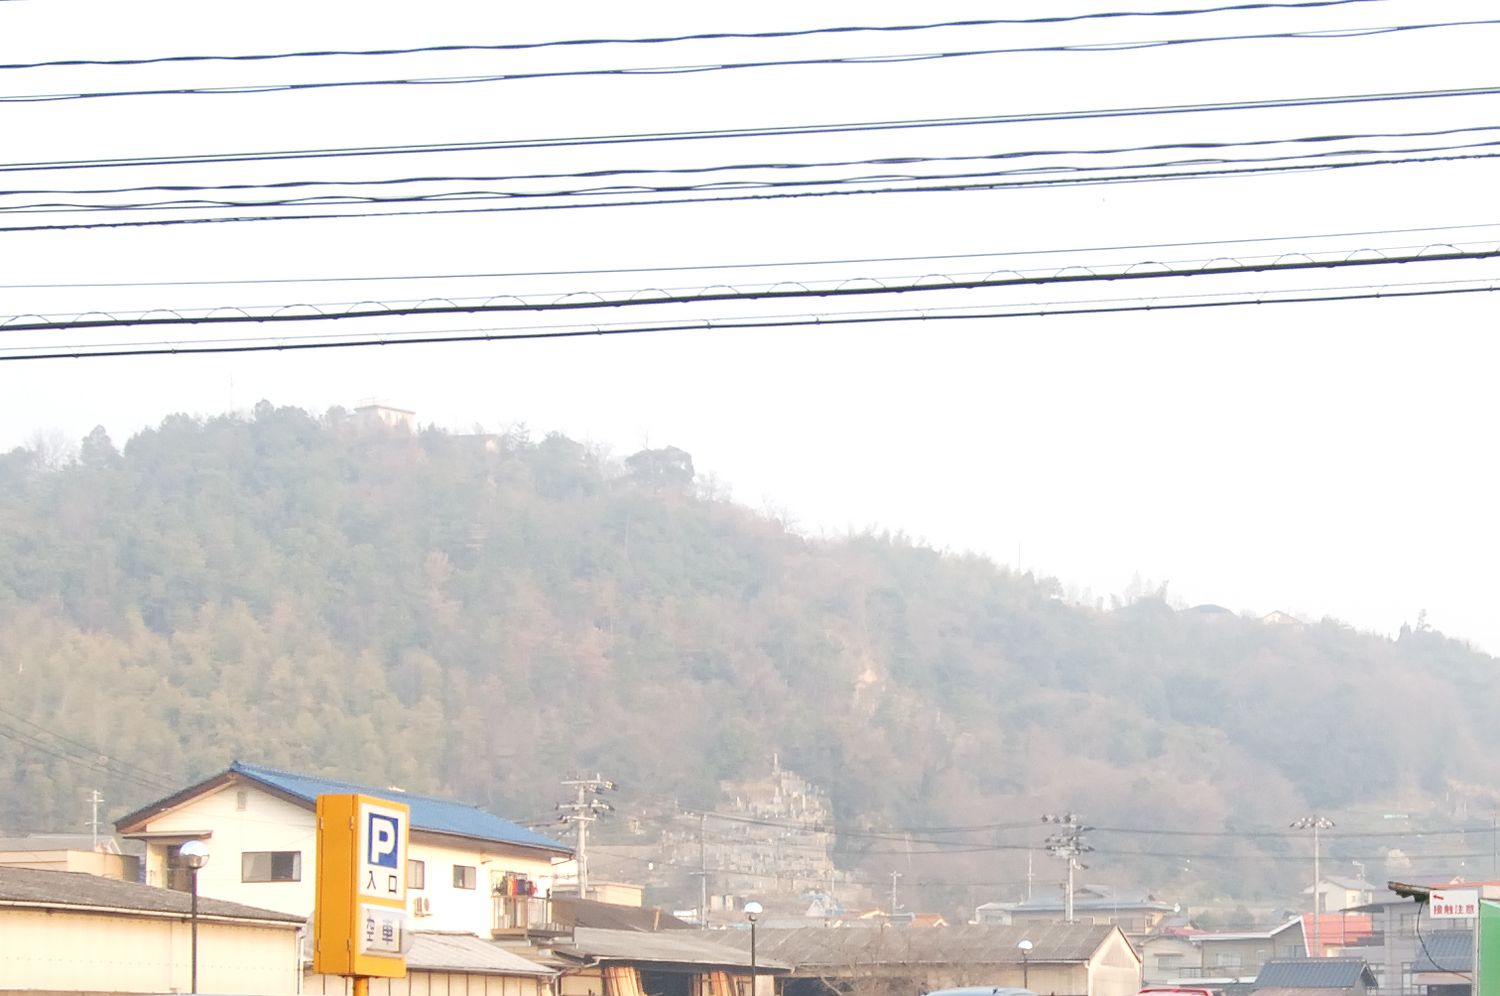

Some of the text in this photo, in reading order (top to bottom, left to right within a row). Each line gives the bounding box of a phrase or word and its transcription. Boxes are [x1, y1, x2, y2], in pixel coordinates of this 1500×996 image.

[371, 817, 396, 863] P
[366, 870, 398, 894] 入口
[365, 917, 394, 945] 空車
